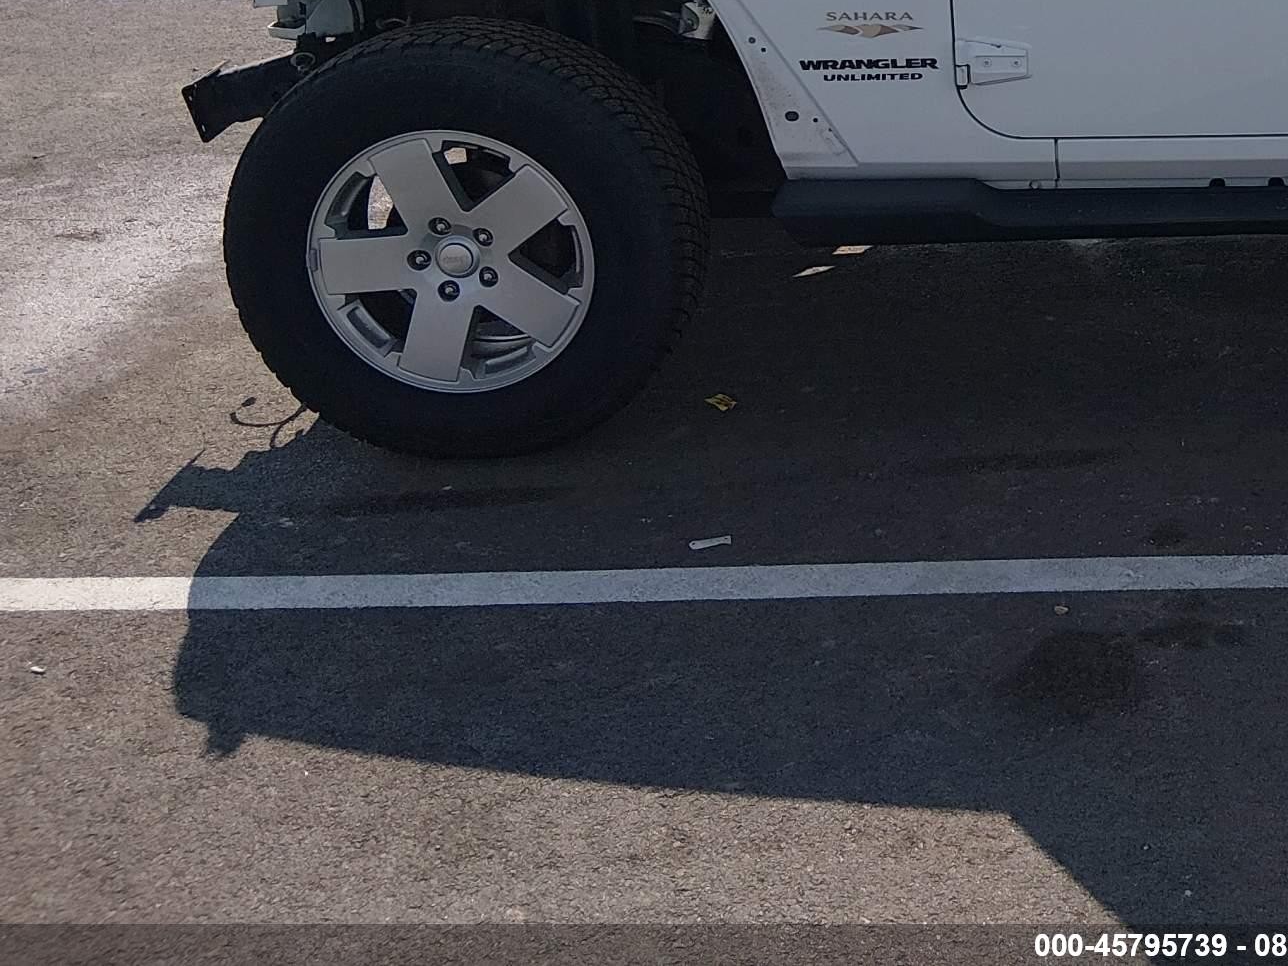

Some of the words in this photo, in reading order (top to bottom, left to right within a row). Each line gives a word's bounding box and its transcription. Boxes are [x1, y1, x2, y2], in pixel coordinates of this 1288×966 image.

[826, 11, 914, 22] SAHARA
[799, 58, 939, 71] WRANGLER
[823, 73, 923, 82] UNLIMITED
